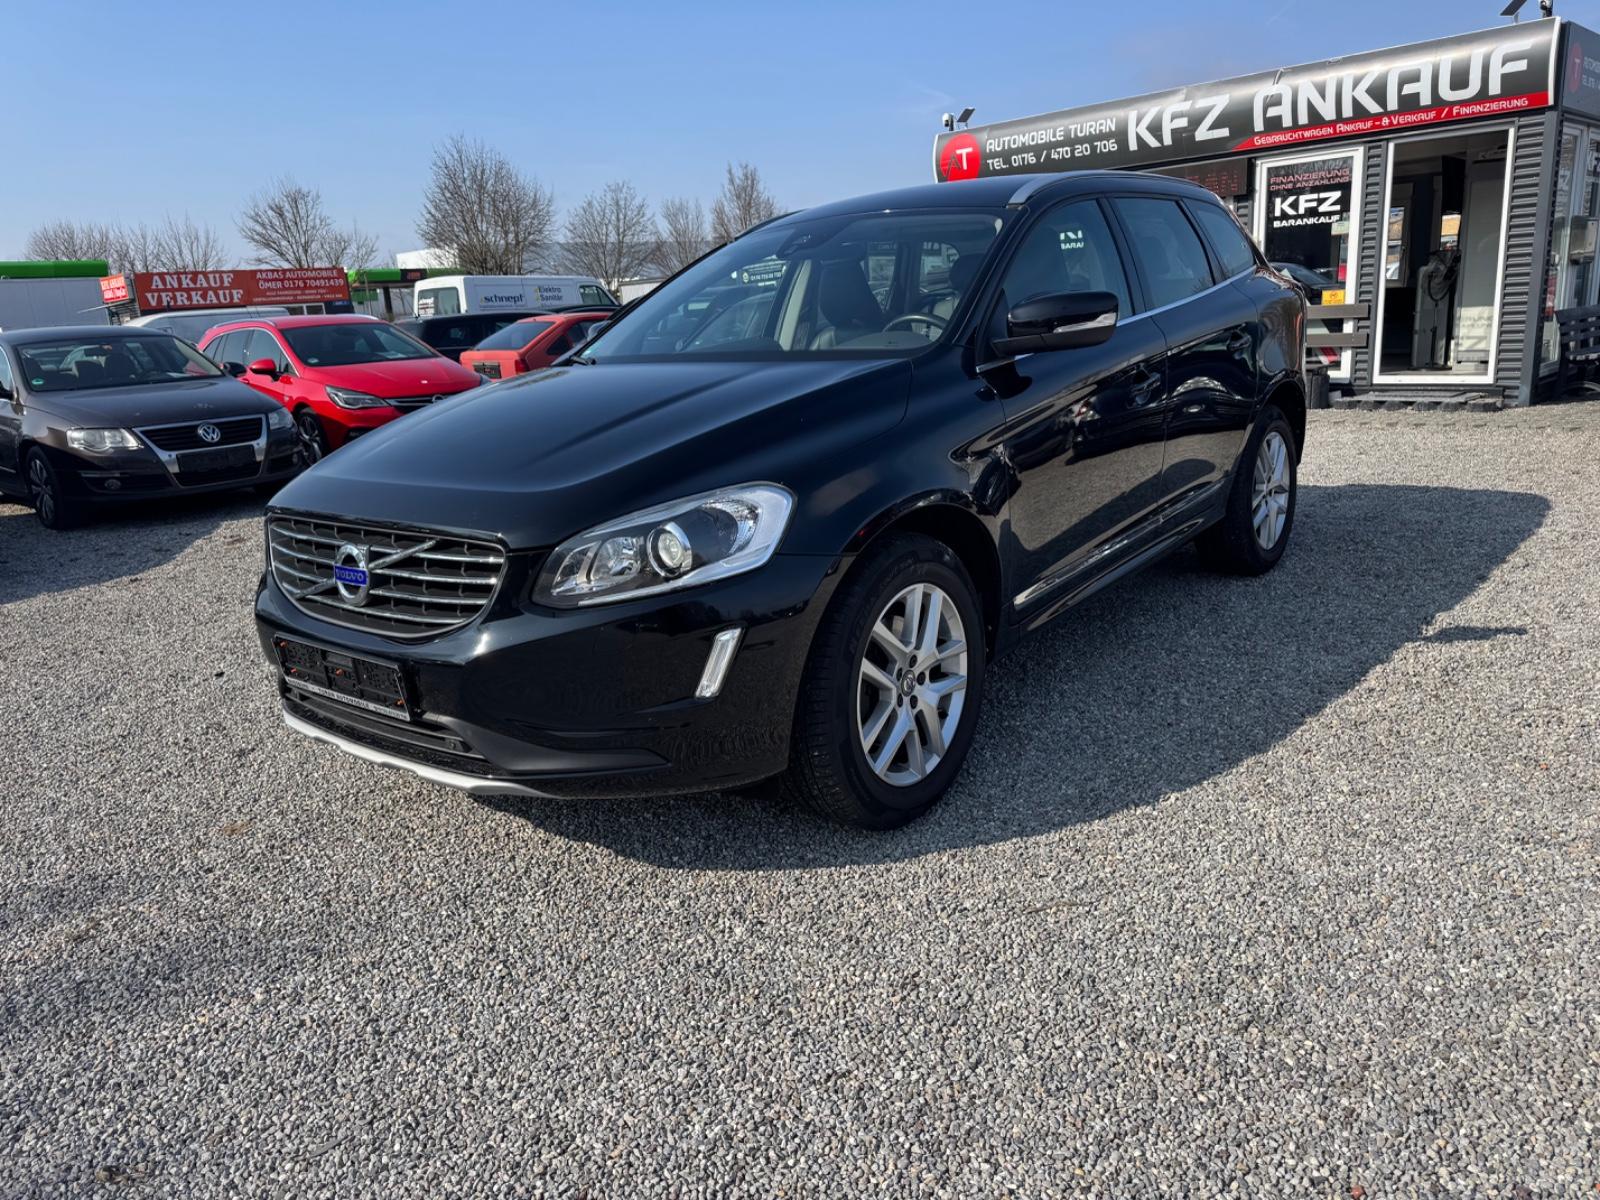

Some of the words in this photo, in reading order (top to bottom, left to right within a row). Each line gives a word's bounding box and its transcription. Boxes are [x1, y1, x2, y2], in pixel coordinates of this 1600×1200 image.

[1128, 94, 1230, 151] KFZ
[1253, 42, 1534, 132] ANKAUF
[1391, 110, 1437, 125] VERKAUF
[1452, 97, 1529, 116] FINANZIERUNG
[986, 127, 1064, 152] AUTOMOBILE
[1069, 117, 1116, 139] TURAN
[987, 159, 1009, 171] TEL.
[1011, 152, 1037, 167] 0176
[1040, 151, 1047, 163] /
[1051, 147, 1071, 160] 470
[1074, 143, 1091, 157] 20
[1096, 139, 1118, 153] 706
[1270, 168, 1350, 184] FINANZIERUNG
[1270, 183, 1294, 191] OHNE
[1296, 176, 1350, 188] ANZAHLUNG
[1274, 190, 1342, 217] KFZ
[1273, 215, 1341, 228] BARANKAUF
[151, 273, 234, 289] ANKAUF
[285, 269, 338, 278] AUTOMOBILE
[284, 280, 304, 288] 0176
[145, 289, 244, 306] VERKAUF
[484, 293, 524, 304] schnepf
[335, 568, 364, 582] VOLVO
